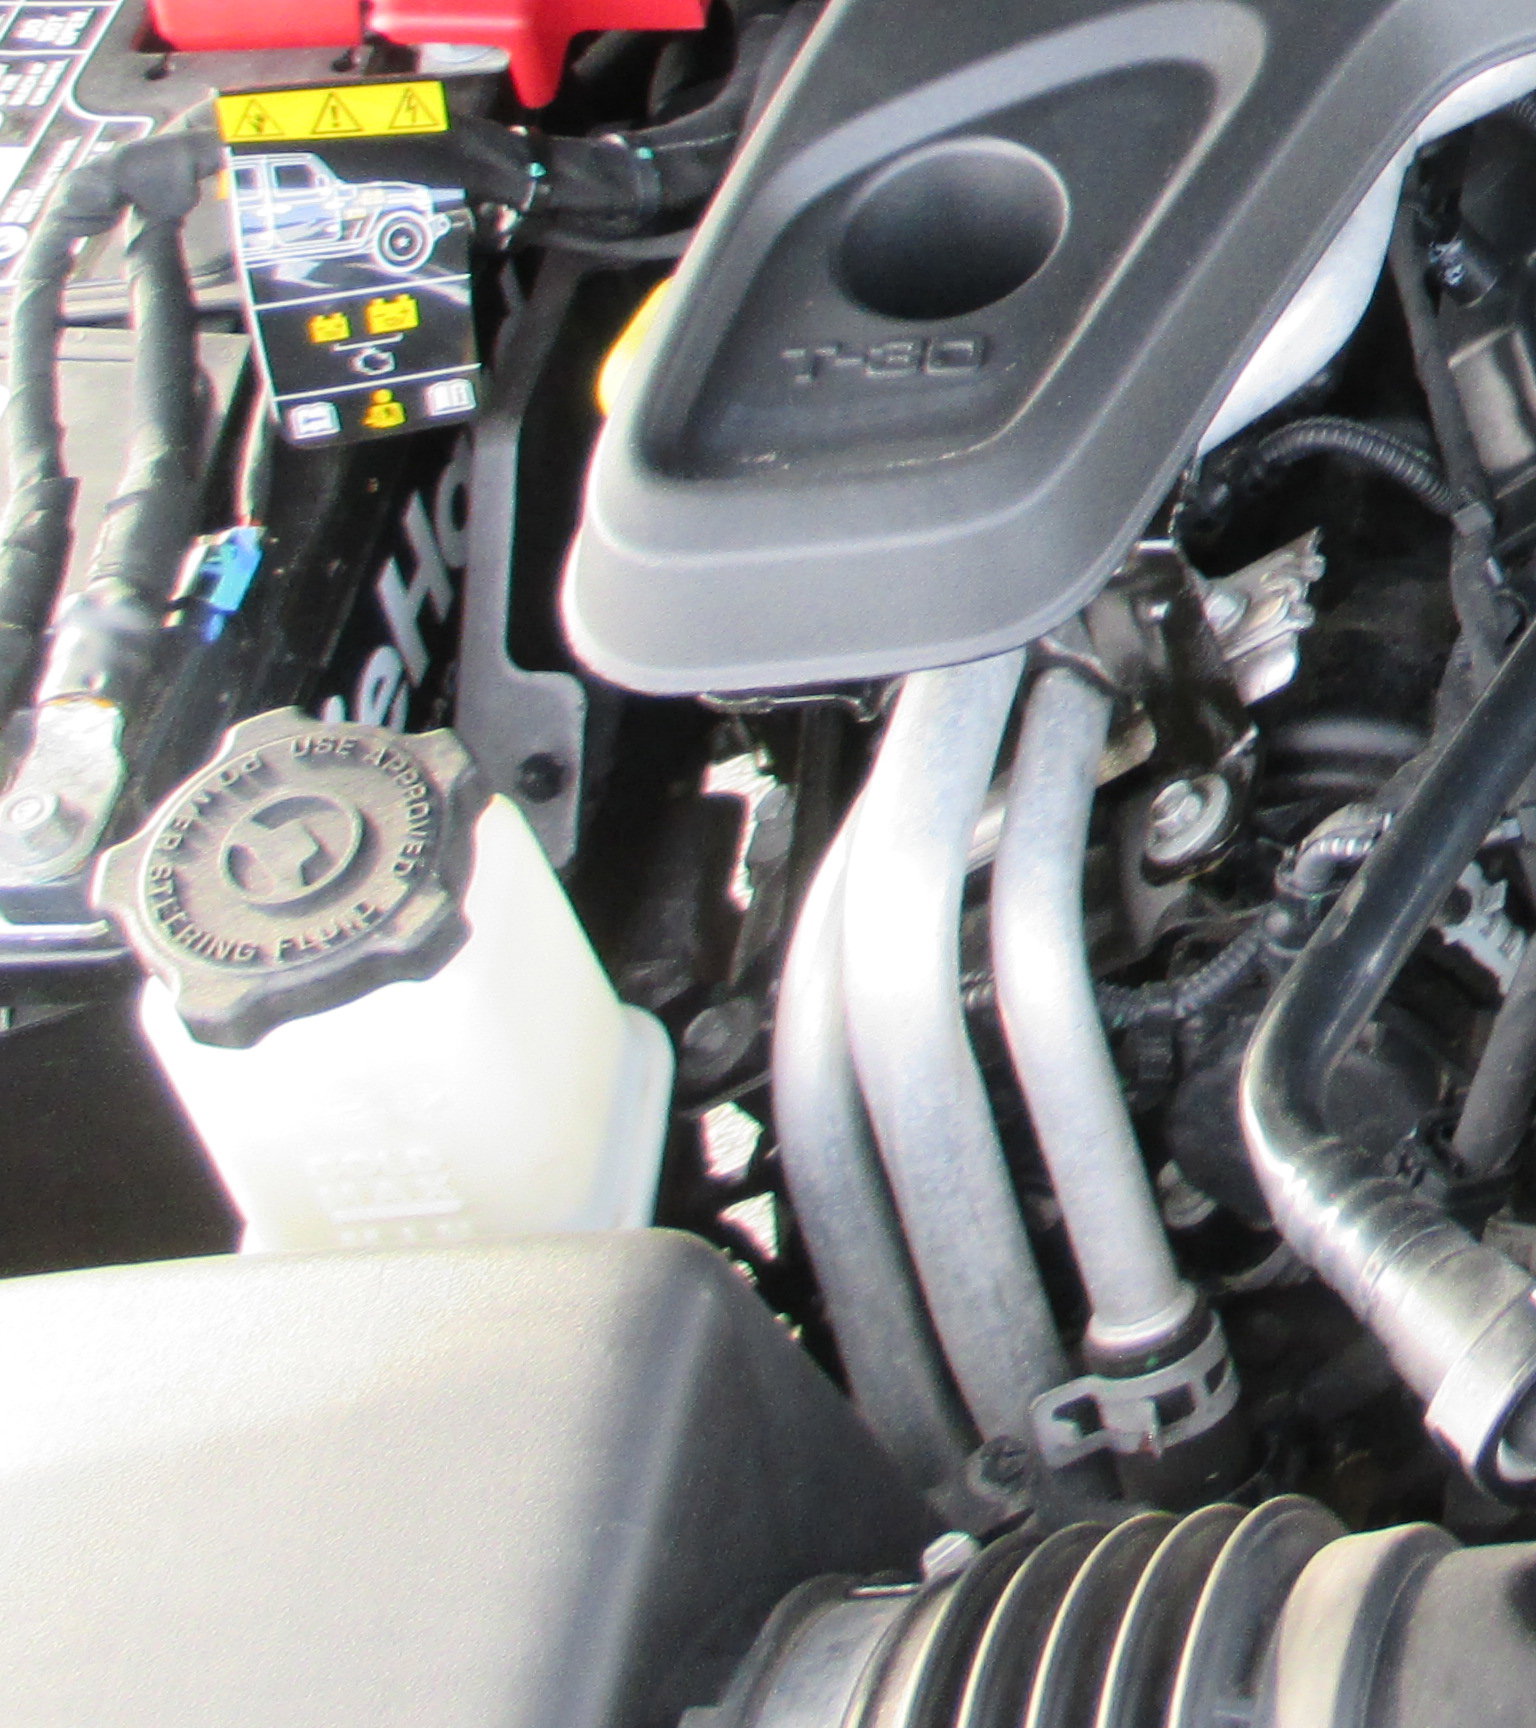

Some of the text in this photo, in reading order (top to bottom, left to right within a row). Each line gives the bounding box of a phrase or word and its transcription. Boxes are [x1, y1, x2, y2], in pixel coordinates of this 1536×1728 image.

[148, 751, 384, 963] POWER STEERING FLUID
[290, 736, 433, 877] USE APPROVED
